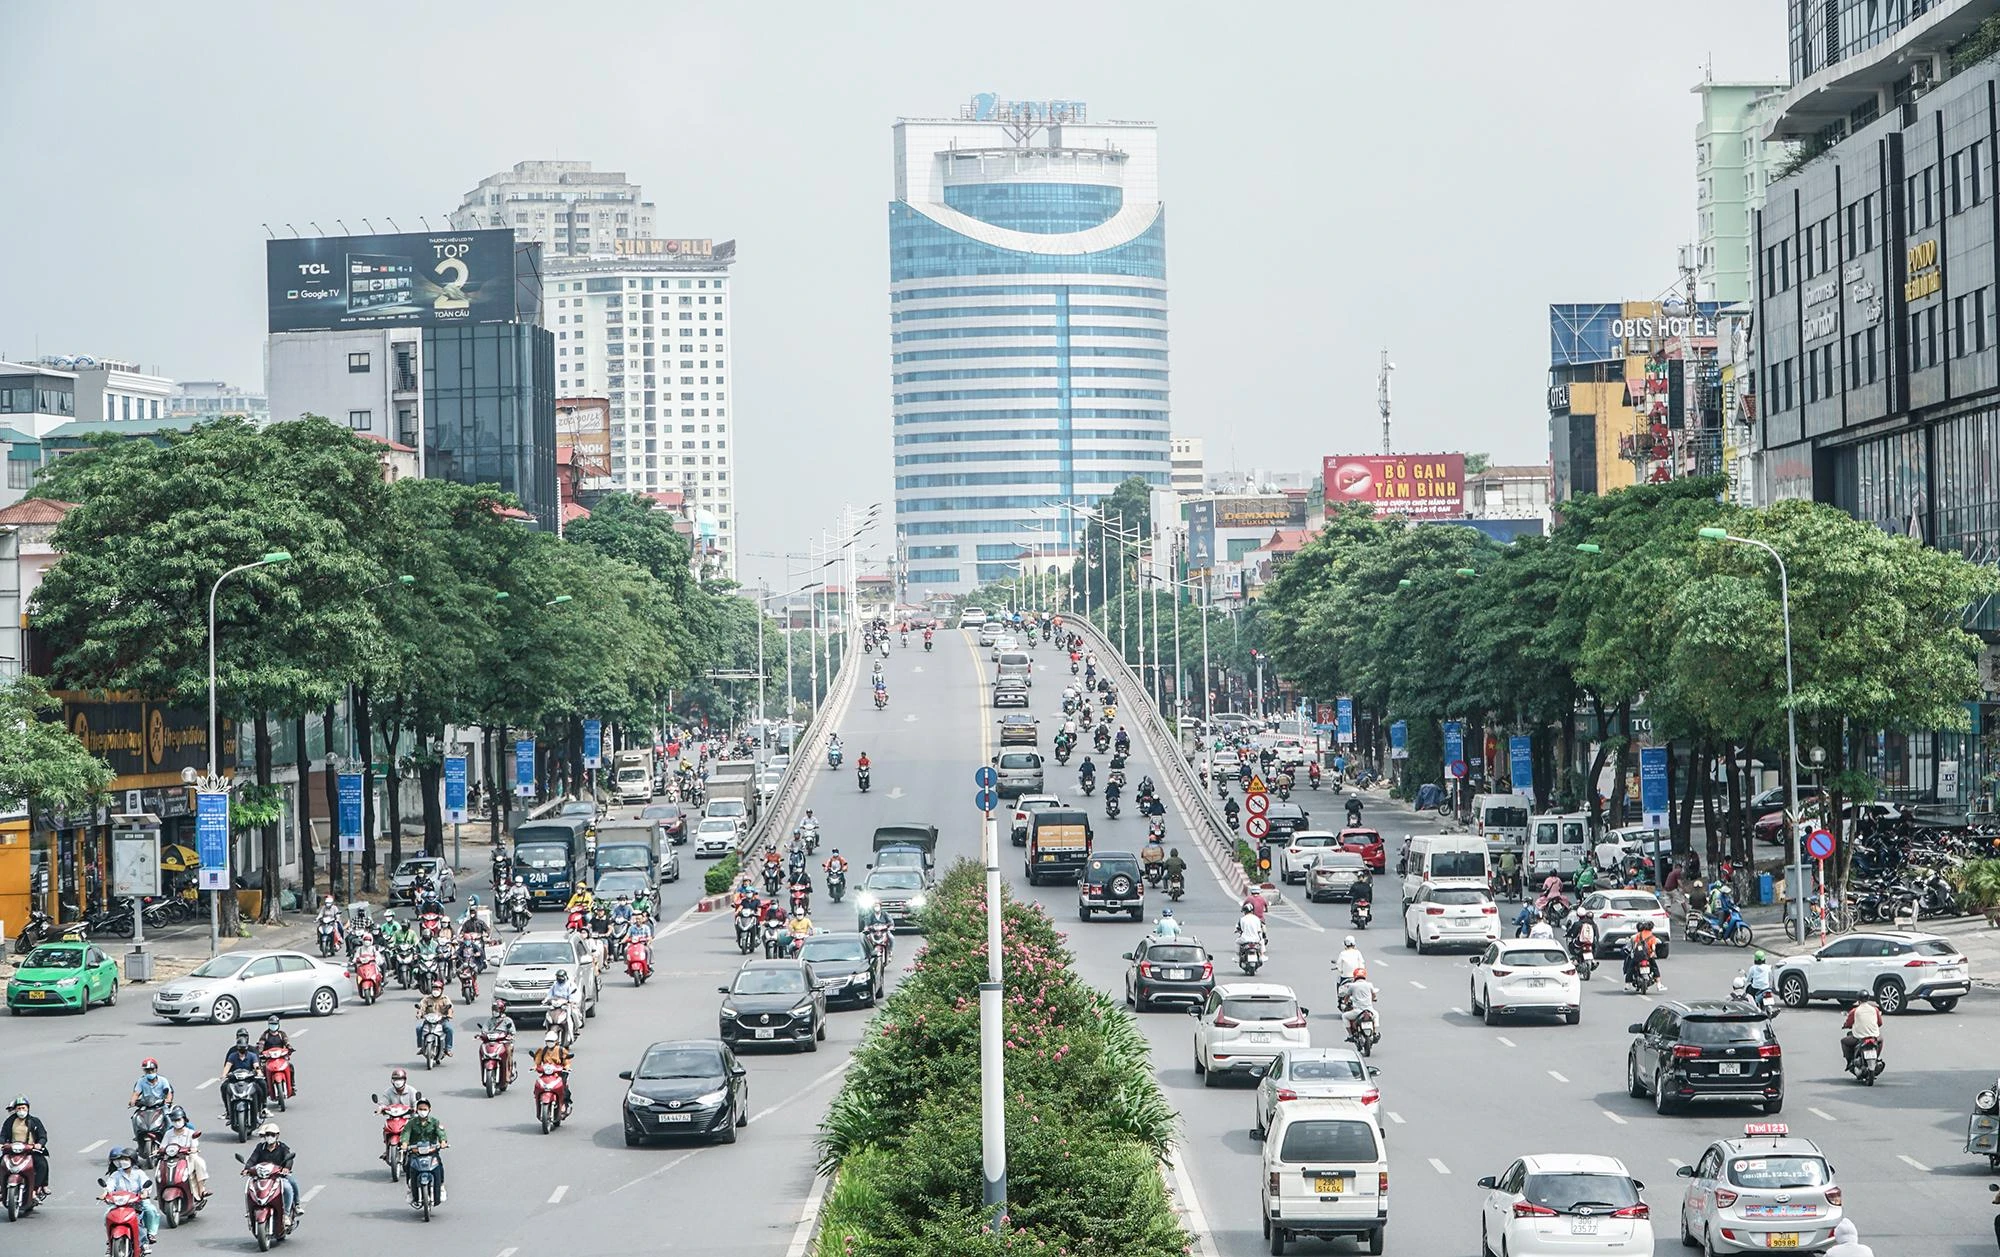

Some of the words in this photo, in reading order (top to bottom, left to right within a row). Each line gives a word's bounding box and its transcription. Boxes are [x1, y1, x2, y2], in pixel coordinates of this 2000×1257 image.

[433, 244, 470, 258] TOP
[614, 239, 645, 255] SUN
[298, 263, 330, 275] TCL
[434, 257, 469, 310] 2
[301, 289, 328, 300] Google
[329, 289, 339, 297] TV
[1612, 318, 1652, 338] OBIS
[1658, 317, 1715, 337] HOTEL
[1384, 457, 1407, 479] BỔ
[1413, 463, 1446, 479] GAN
[1375, 480, 1410, 498] TÂM
[1417, 479, 1456, 497] BÌNH
[529, 872, 548, 883] 24h
[1750, 1123, 1766, 1132] Taxi
[1767, 1123, 1785, 1132] 123
